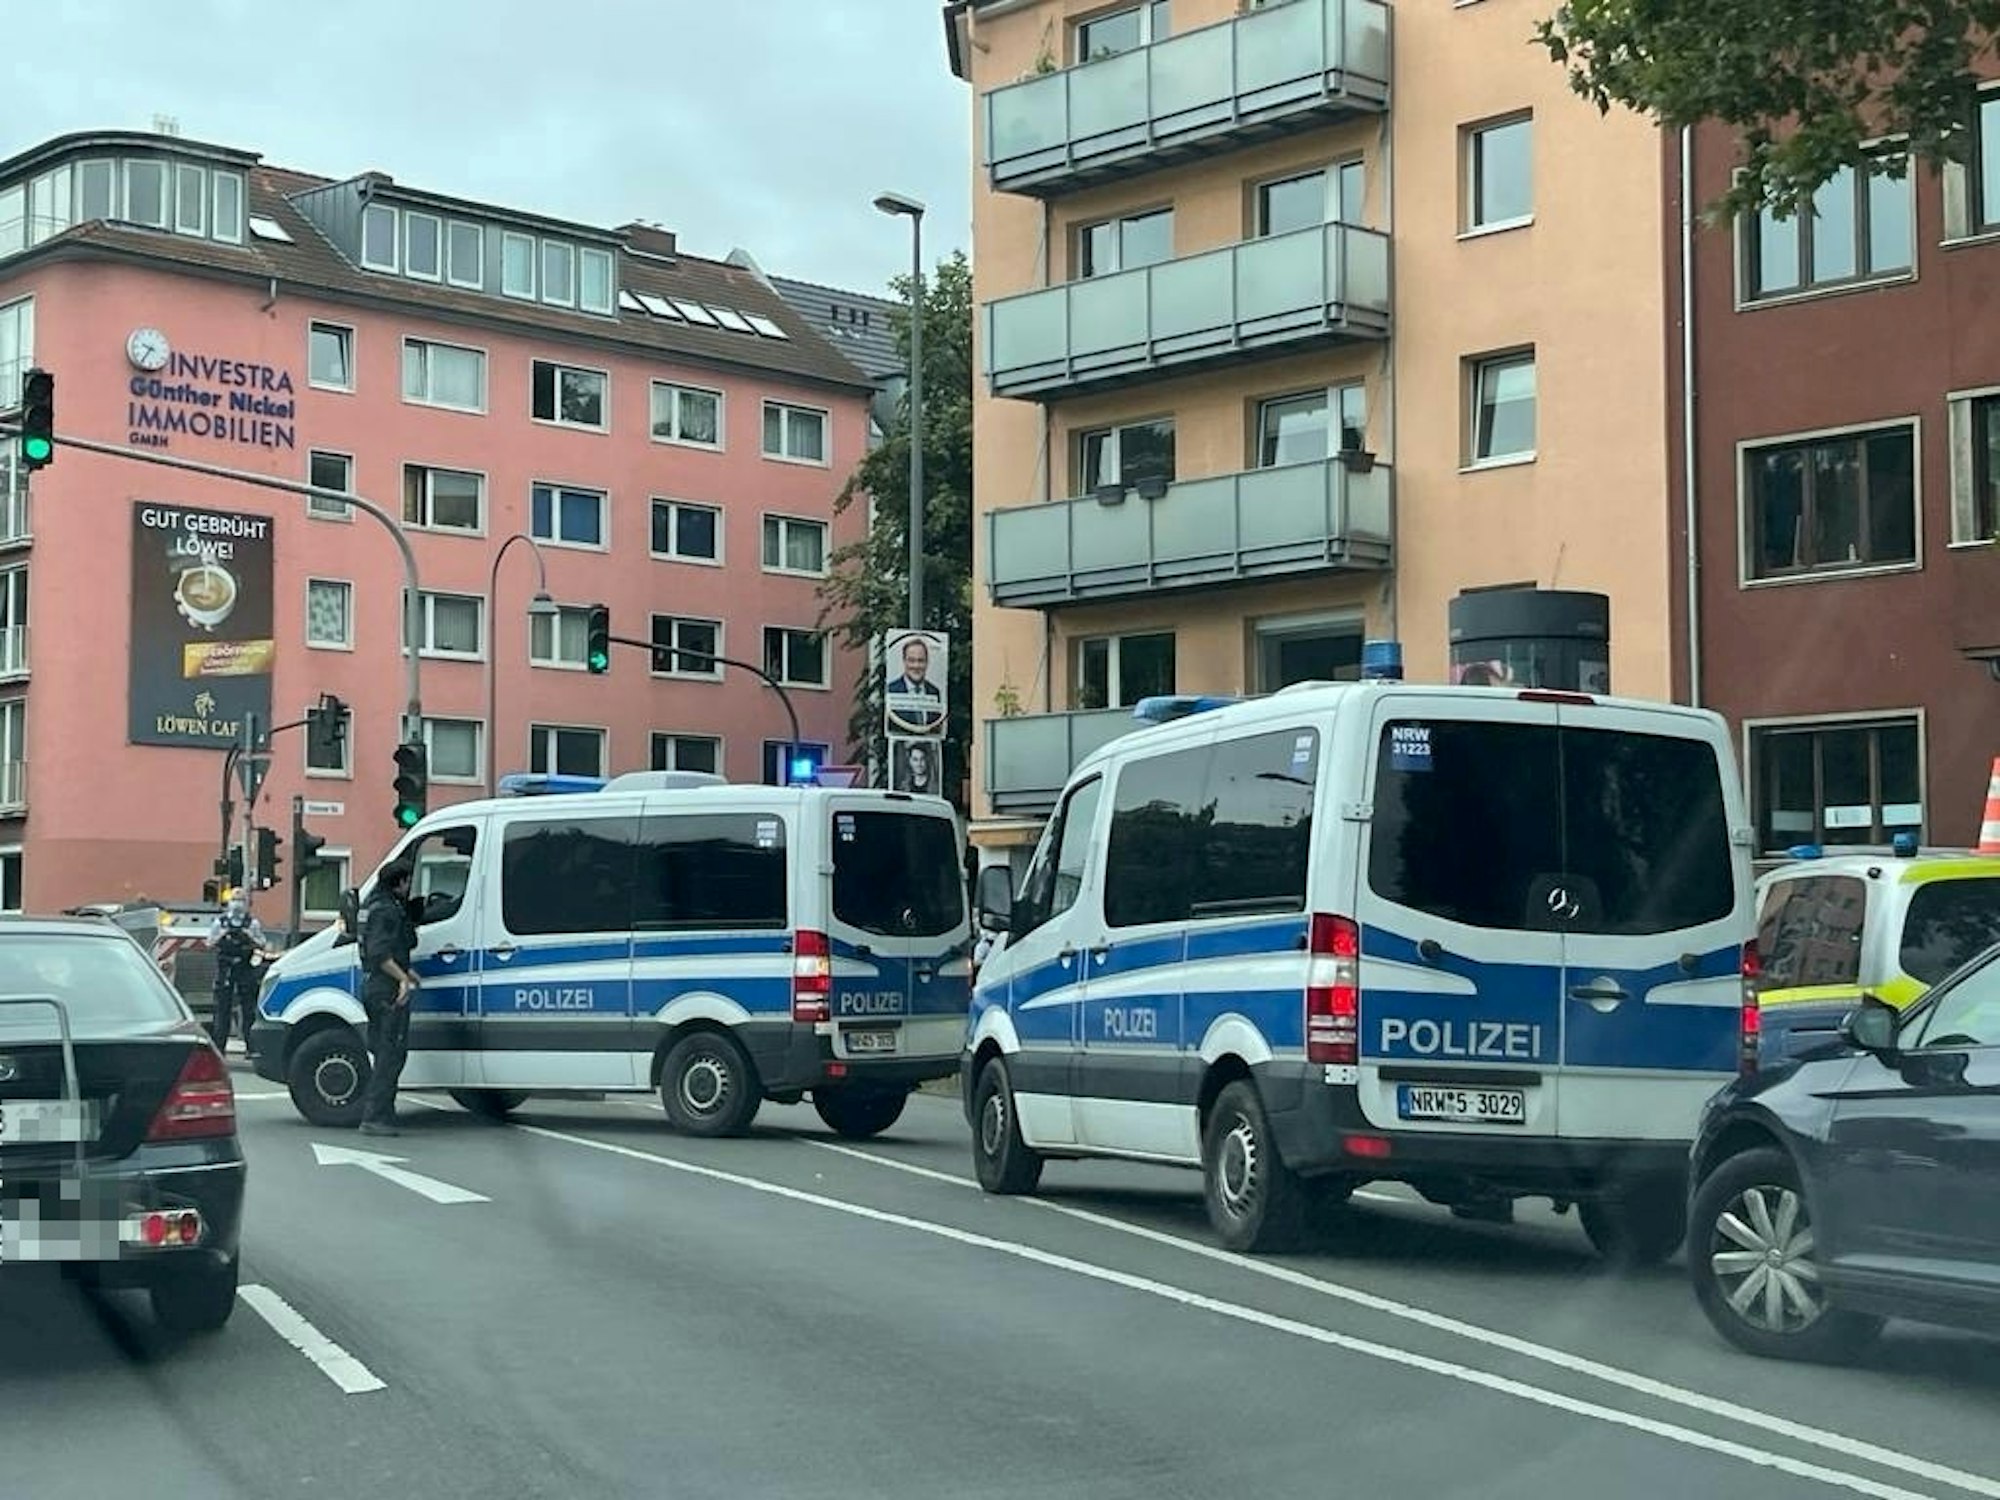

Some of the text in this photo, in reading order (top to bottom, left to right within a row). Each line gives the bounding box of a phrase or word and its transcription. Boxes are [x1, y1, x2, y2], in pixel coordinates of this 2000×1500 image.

[170, 352, 294, 394] INVESTRA
[130, 377, 295, 419] Günther Nickel
[128, 402, 295, 450] IMMOBILIEN
[141, 509, 267, 539] GUT GEBRÜHT
[176, 534, 234, 560] LÖWE!
[156, 714, 241, 737] LÖWEN CAF
[1392, 727, 1431, 741] NRW
[514, 987, 594, 1010] POLIZEI
[840, 992, 904, 1013] POLIZEI
[1104, 1007, 1157, 1038] POLIZEI
[1380, 1018, 1541, 1058] POLIZEI
